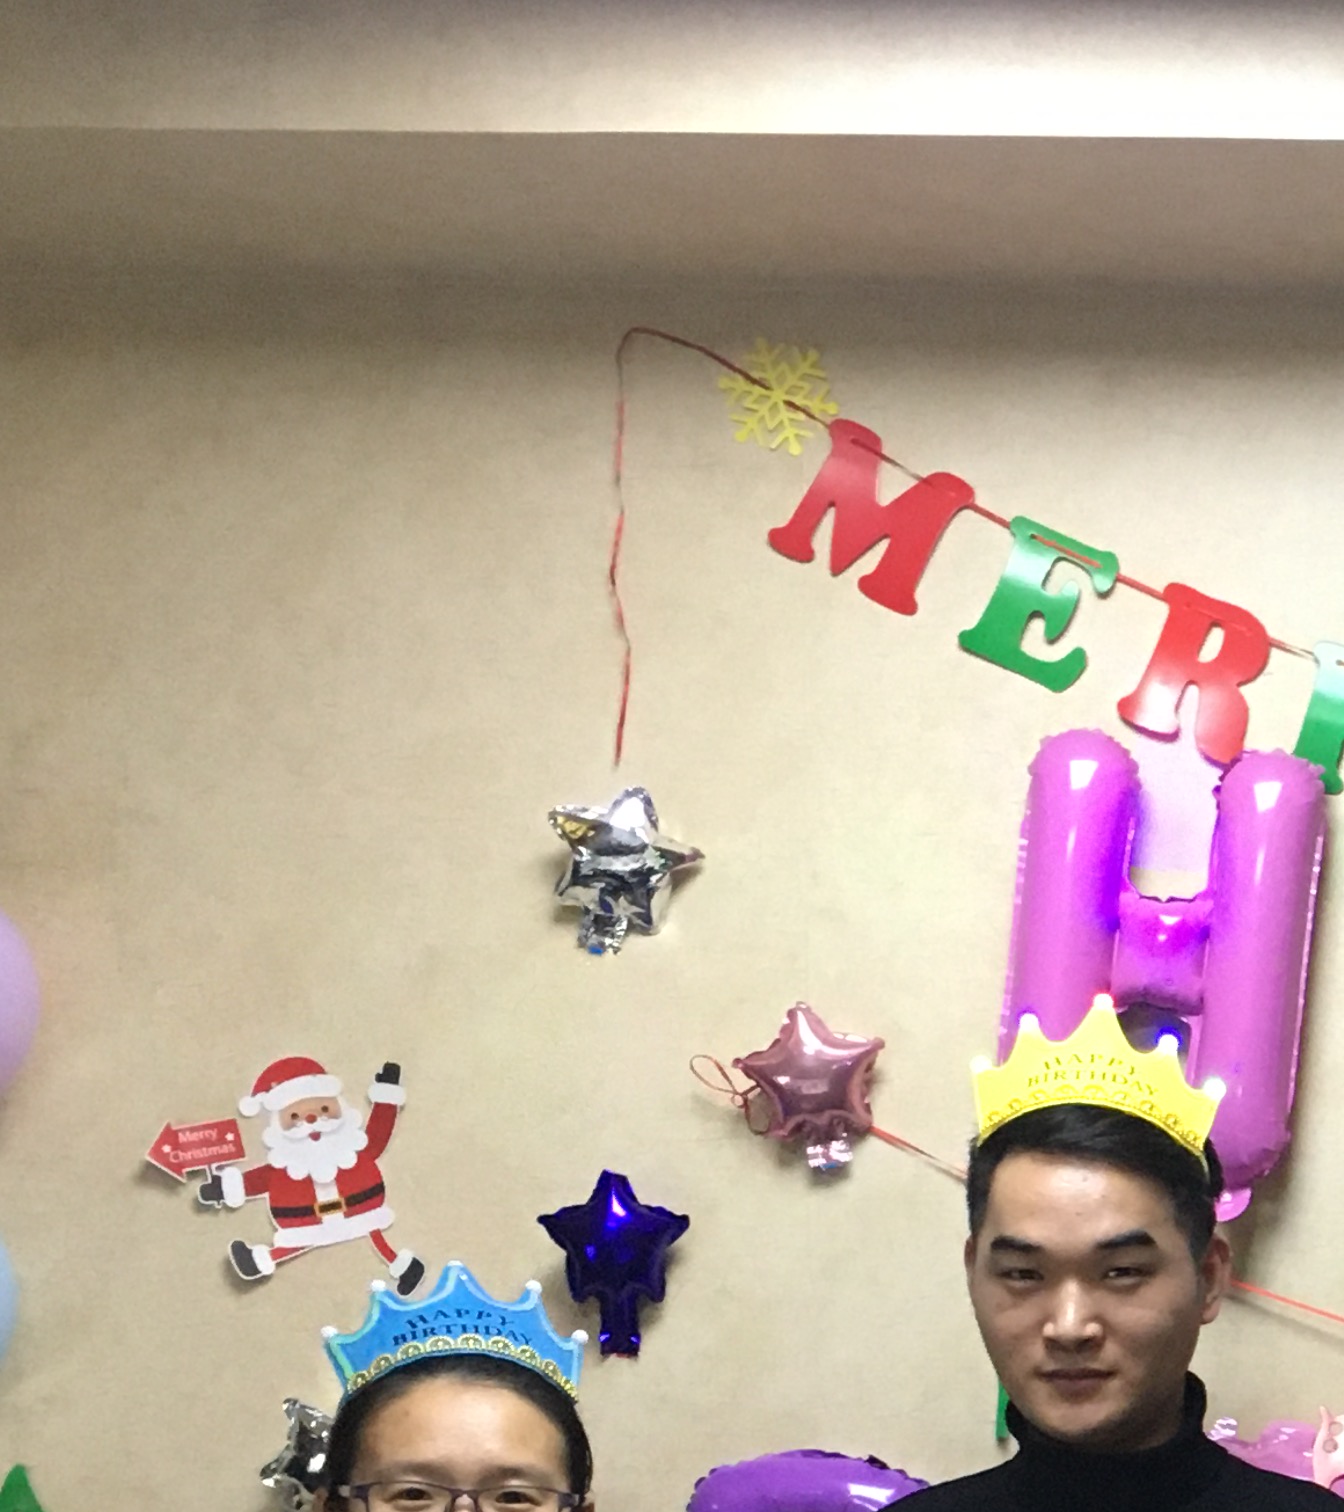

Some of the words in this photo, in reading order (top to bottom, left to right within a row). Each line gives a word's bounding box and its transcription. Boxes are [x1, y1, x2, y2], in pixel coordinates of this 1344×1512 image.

[1044, 1053, 1137, 1076] HAPPY
[1027, 1070, 1159, 1096] BIRTHDAY
[178, 1128, 218, 1142] Merry
[169, 1143, 237, 1163] Christmas
[405, 1307, 515, 1329] HAPPY
[392, 1323, 533, 1347] BIRTHDAY
